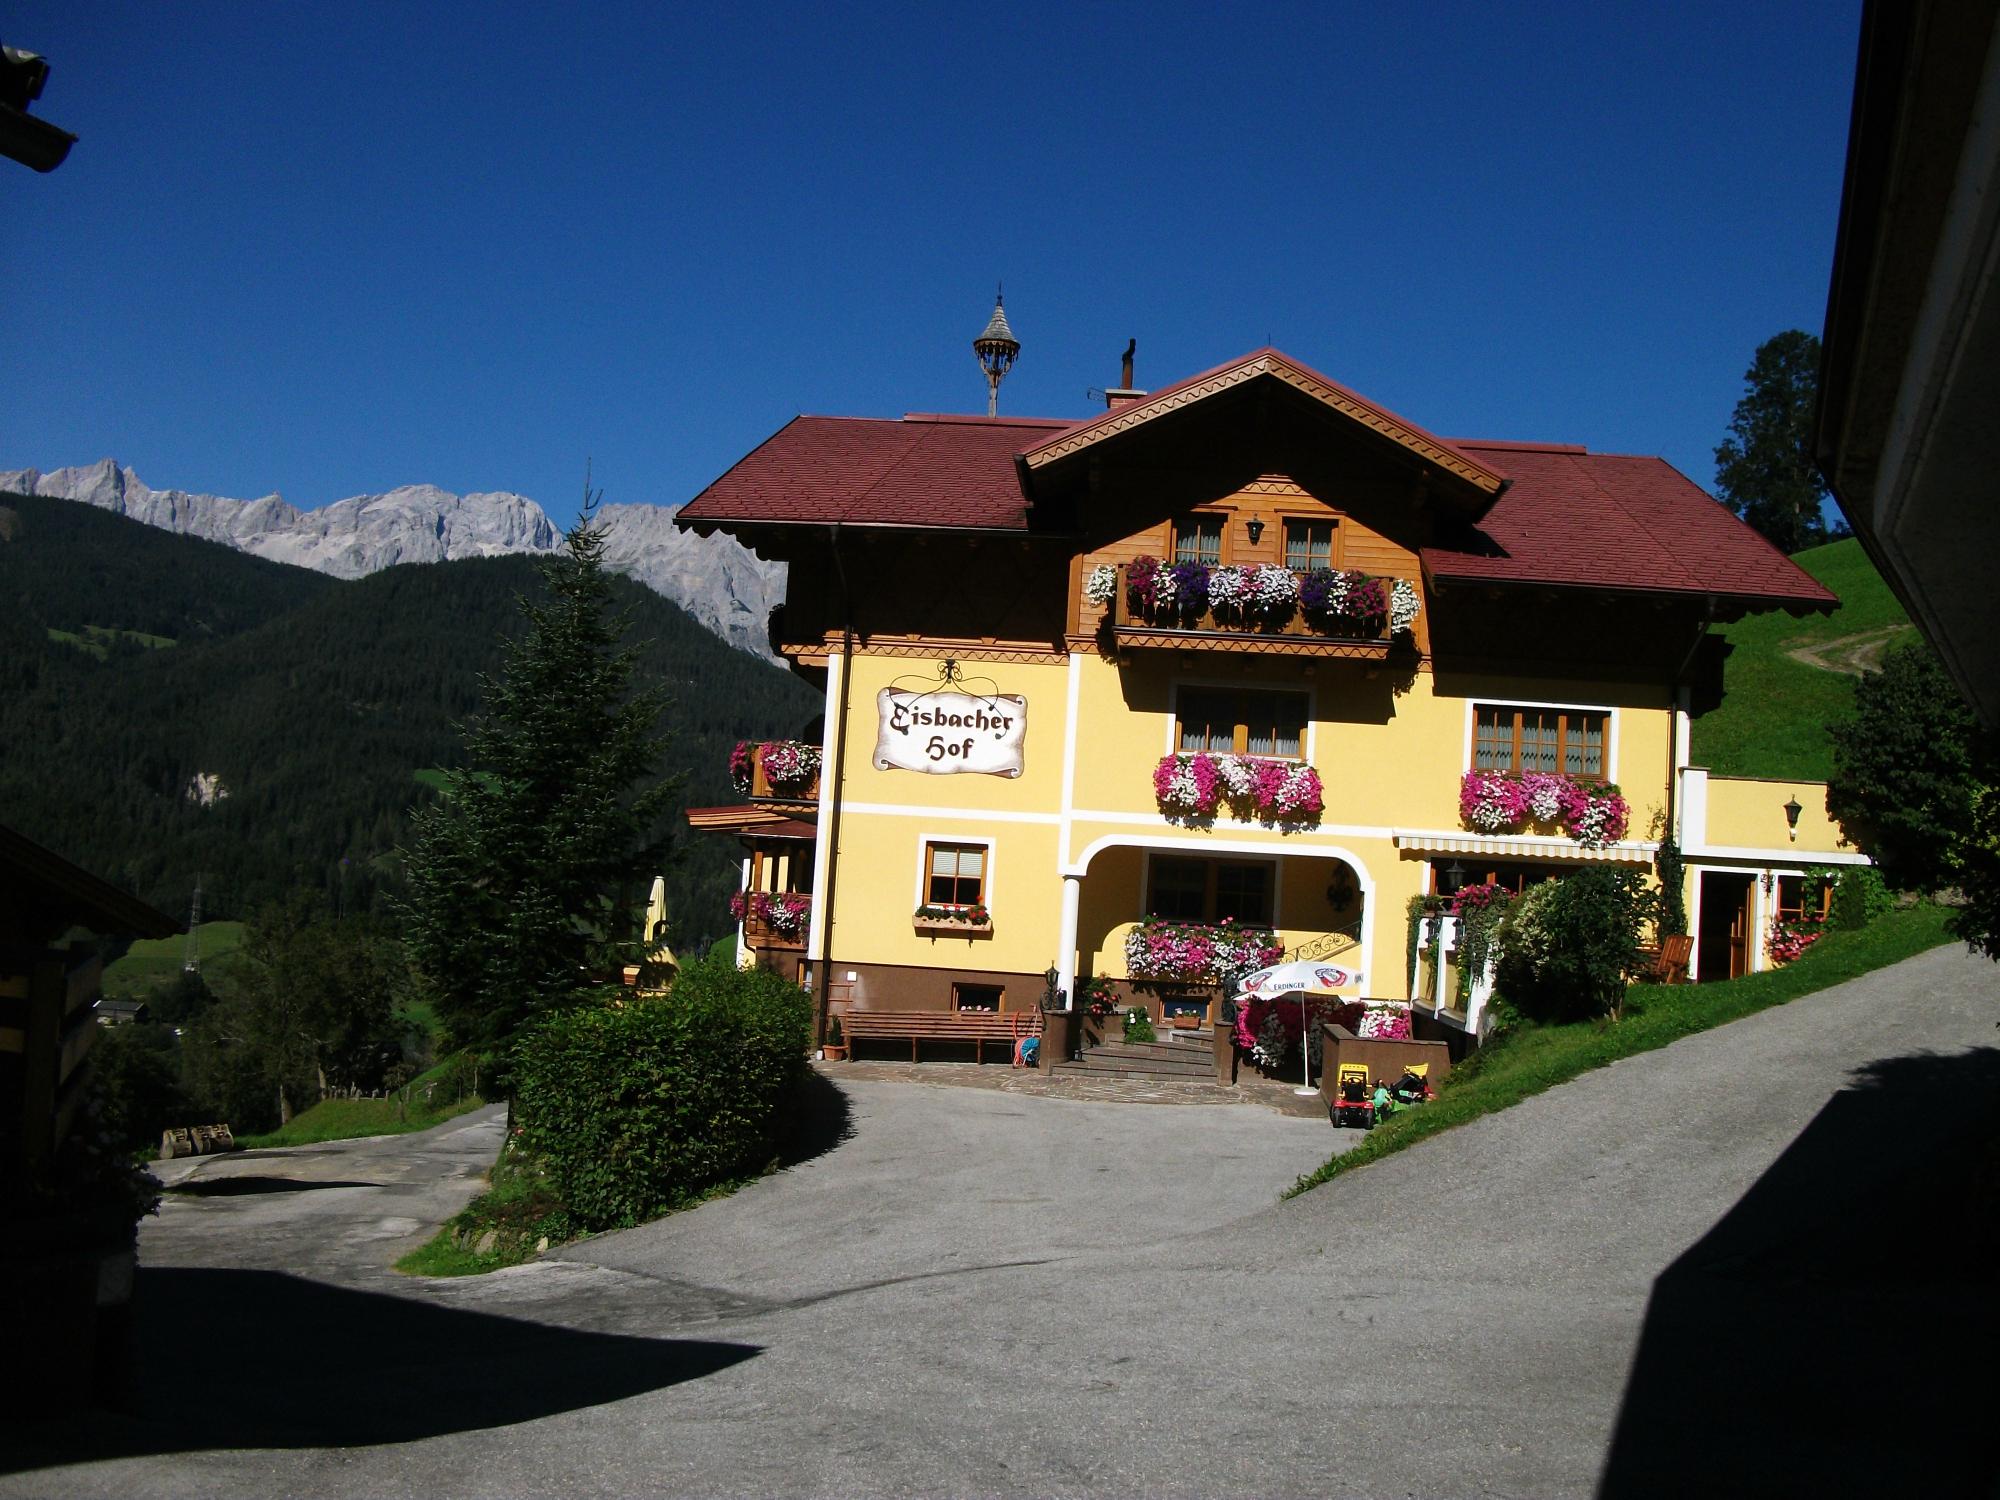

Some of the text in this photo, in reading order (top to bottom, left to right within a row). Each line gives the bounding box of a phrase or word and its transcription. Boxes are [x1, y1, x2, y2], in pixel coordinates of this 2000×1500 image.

[890, 703, 1014, 734] Eisbacher
[925, 735, 975, 761] Hof
[1273, 982, 1305, 990] ERDINGER
